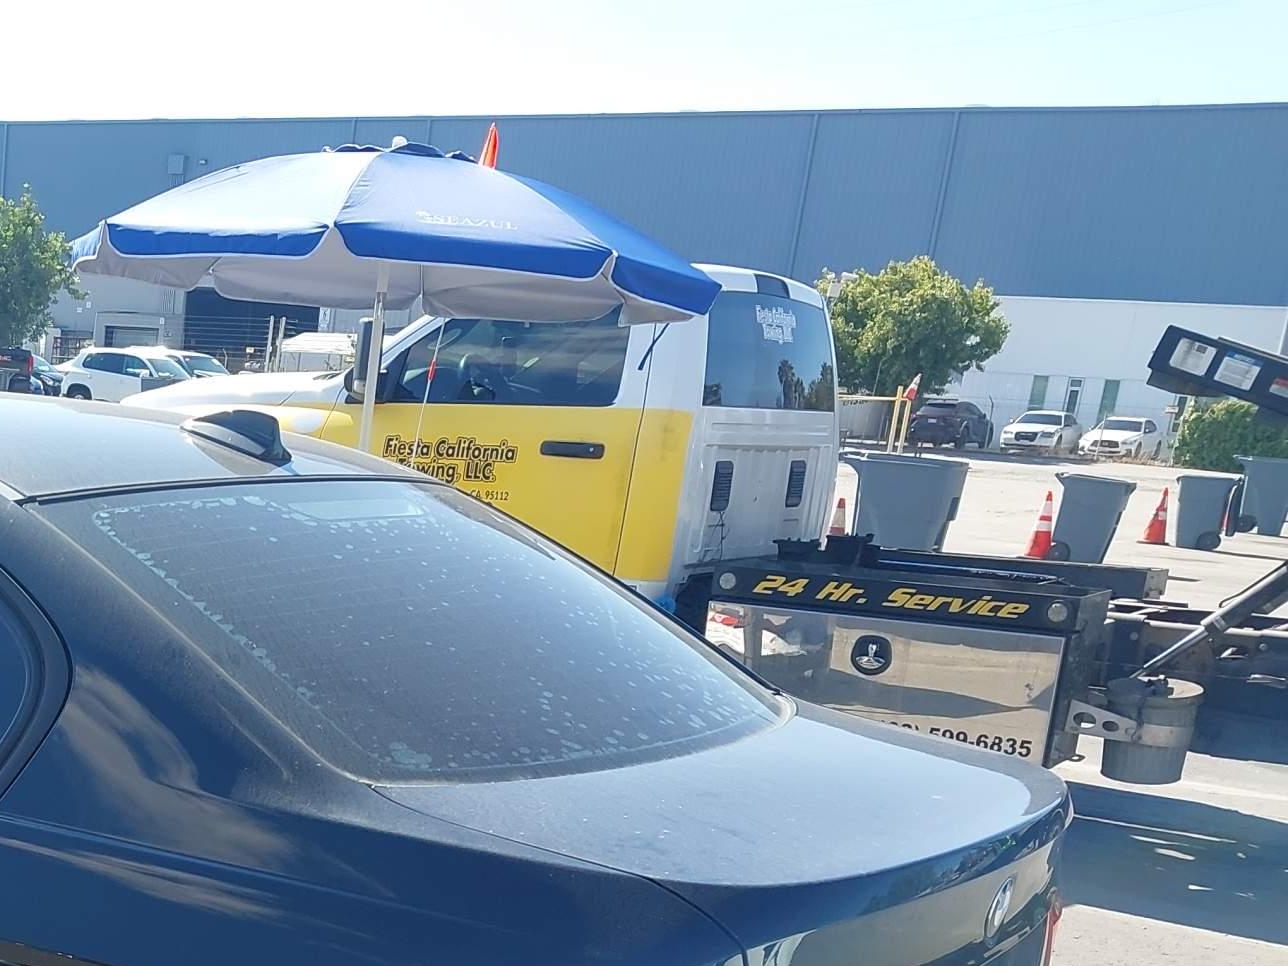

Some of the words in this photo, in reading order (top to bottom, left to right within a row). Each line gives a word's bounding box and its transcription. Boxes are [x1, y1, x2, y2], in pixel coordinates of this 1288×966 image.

[383, 435, 431, 457] Fiesta
[434, 436, 518, 462] California
[463, 460, 496, 482] LLC.
[485, 490, 509, 500] 95112
[752, 575, 809, 596] 24
[815, 581, 868, 604] Hr.
[882, 588, 1030, 619] Service
